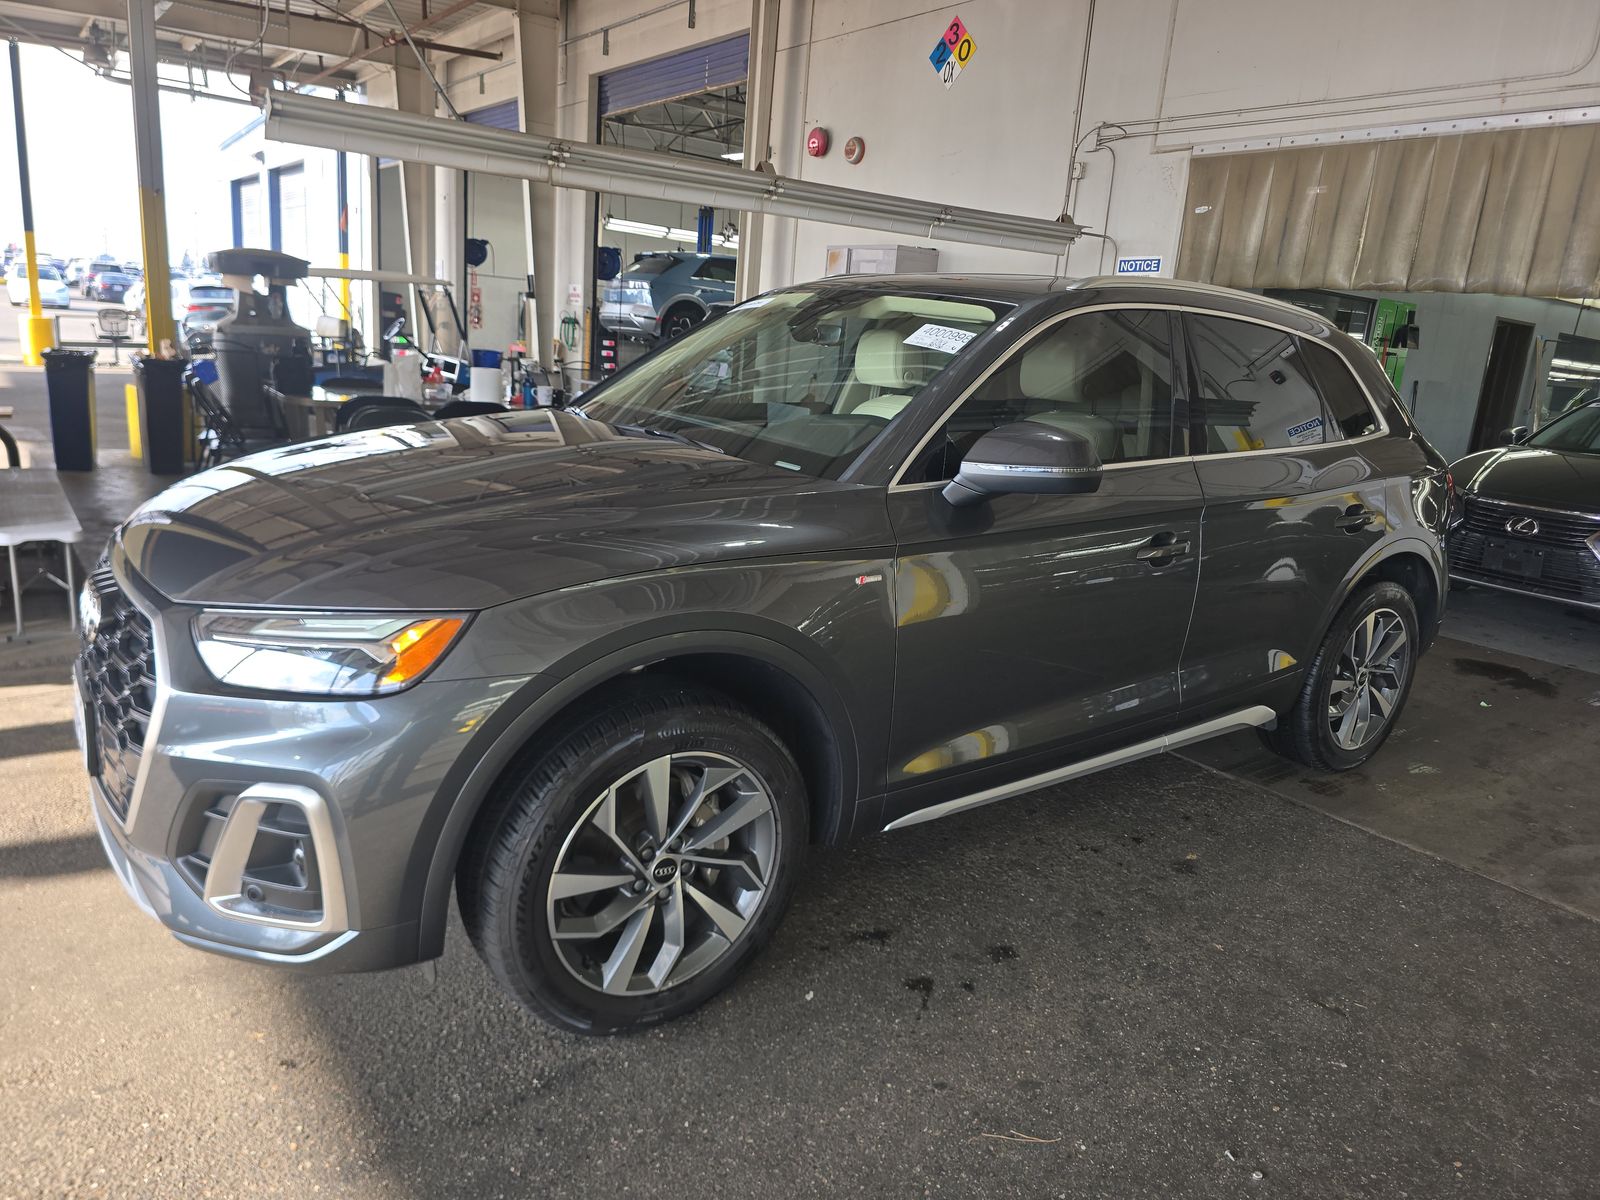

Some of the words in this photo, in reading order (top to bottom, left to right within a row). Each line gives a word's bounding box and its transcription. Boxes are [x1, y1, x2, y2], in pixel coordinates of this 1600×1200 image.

[949, 22, 960, 45] 3
[935, 42, 947, 65] 2
[943, 61, 956, 83] OX
[1120, 260, 1158, 271] NOTICE
